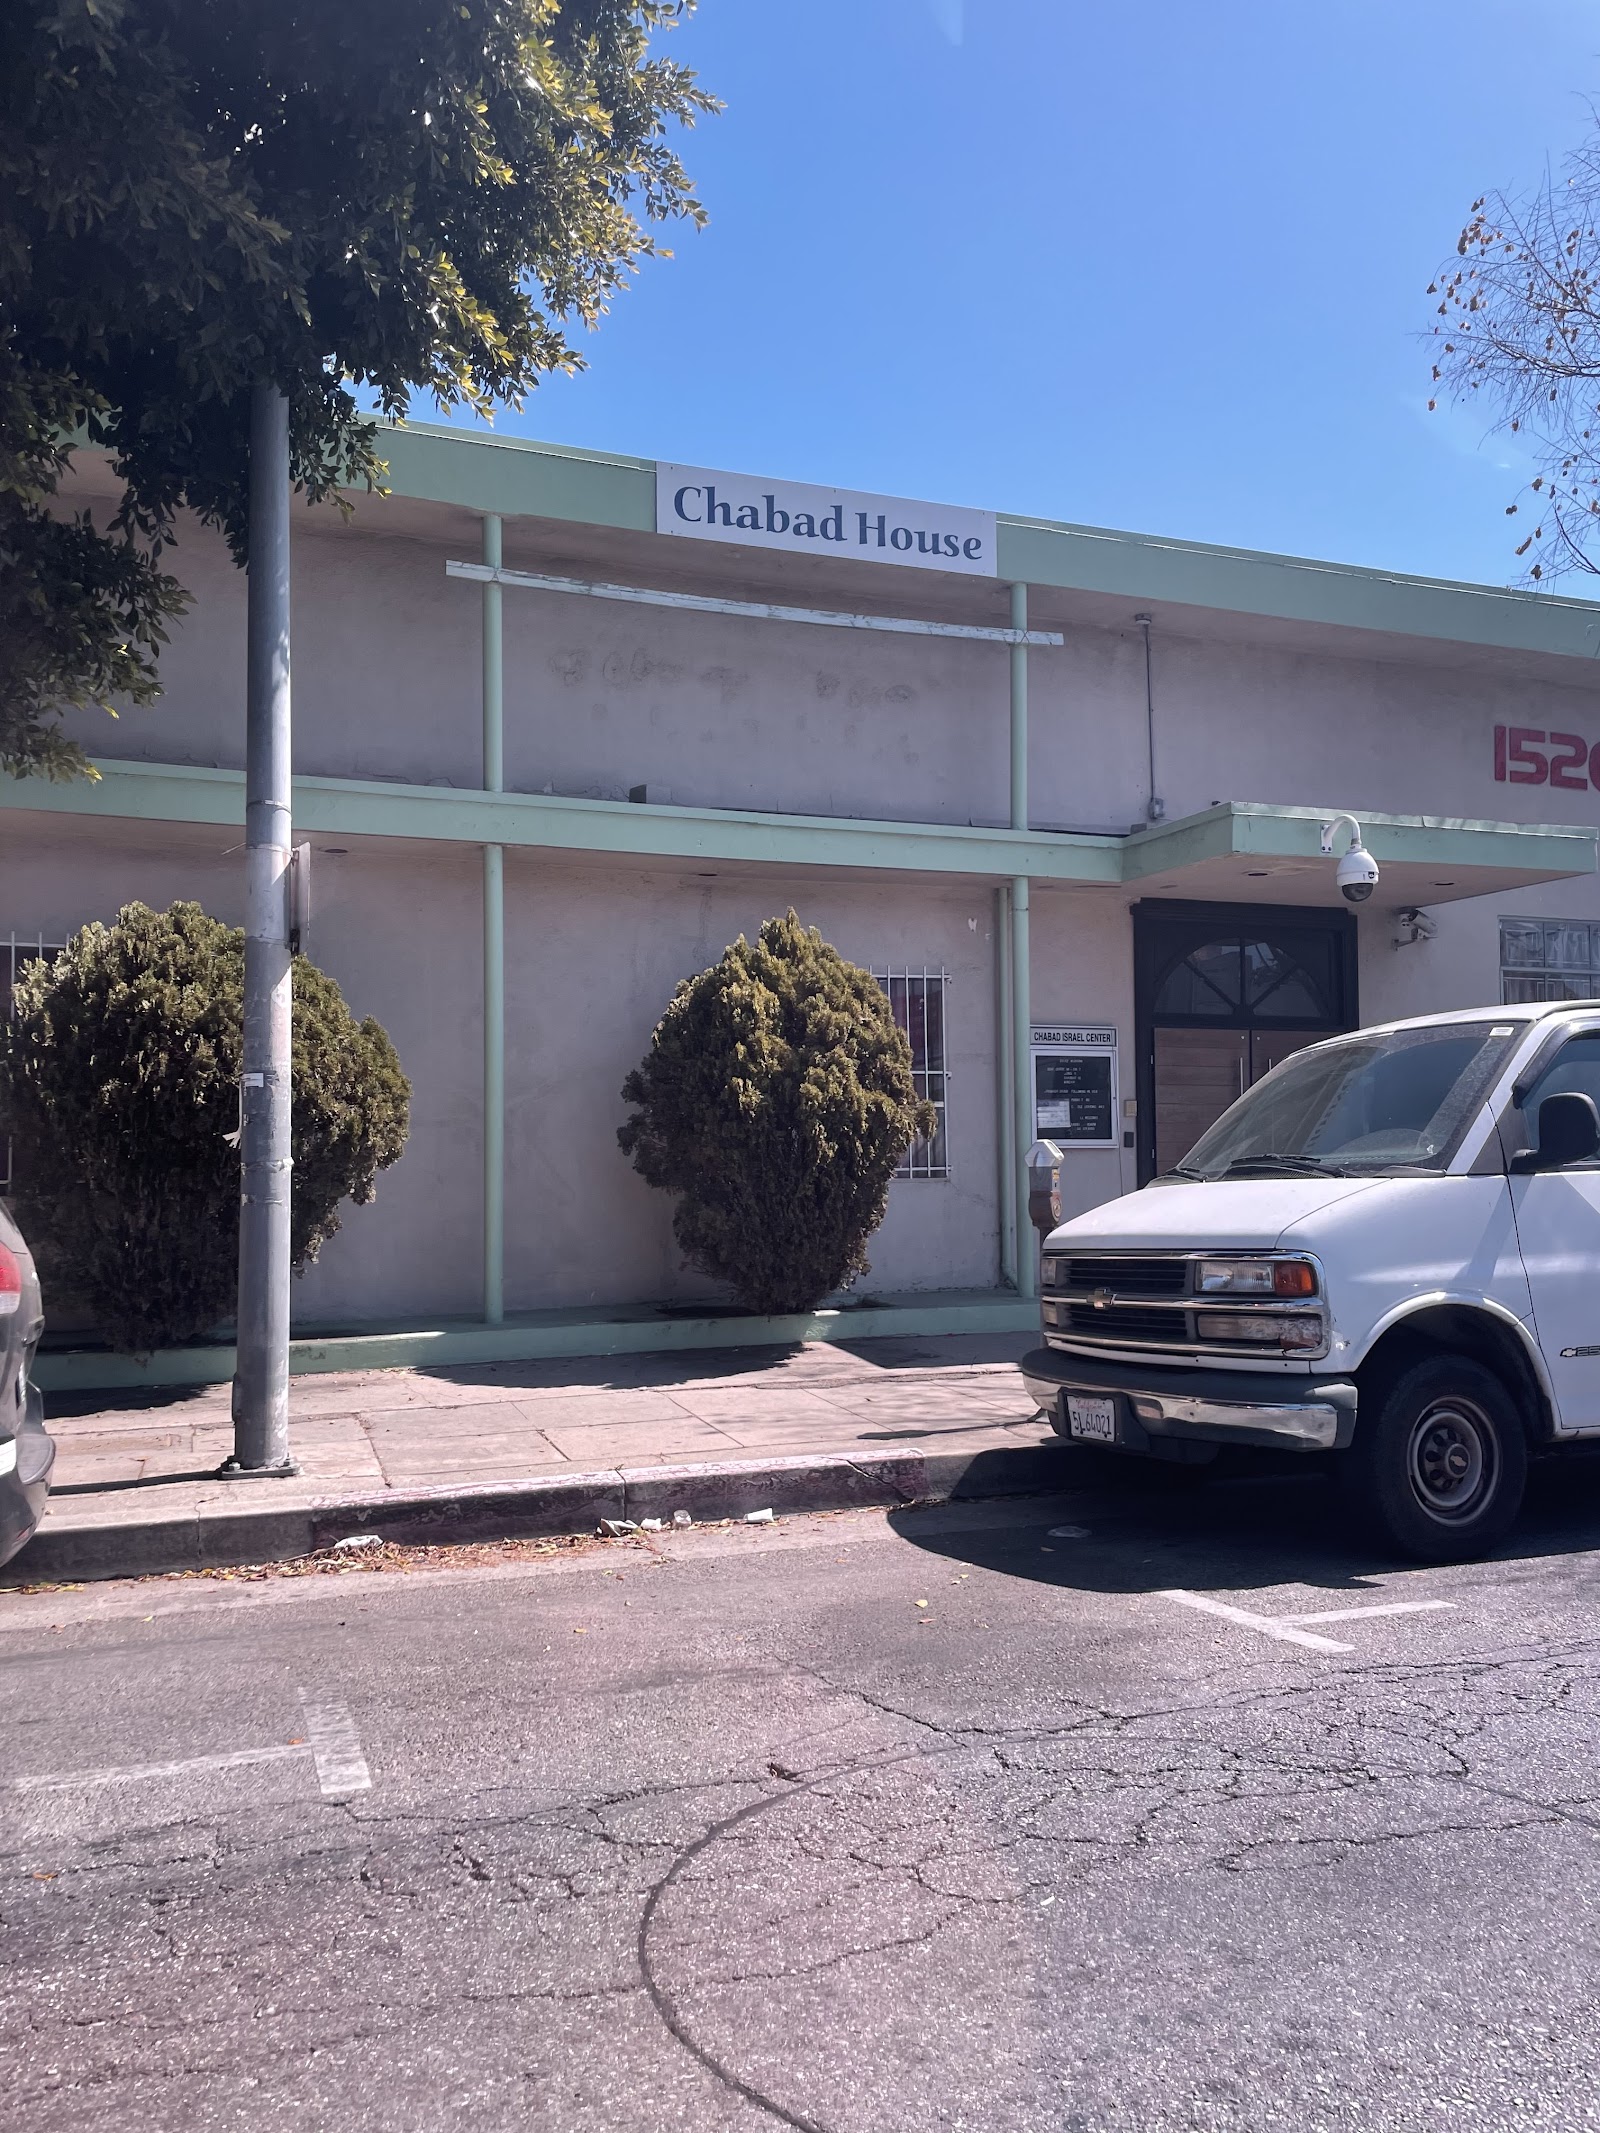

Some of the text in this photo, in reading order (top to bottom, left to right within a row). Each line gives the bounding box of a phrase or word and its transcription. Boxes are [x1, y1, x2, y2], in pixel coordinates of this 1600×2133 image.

[673, 486, 982, 560] Chabad House
[1034, 1032, 1111, 1042] CHABAD ISRAEL CENTER
[1072, 1411, 1112, 1435] 5L64021
